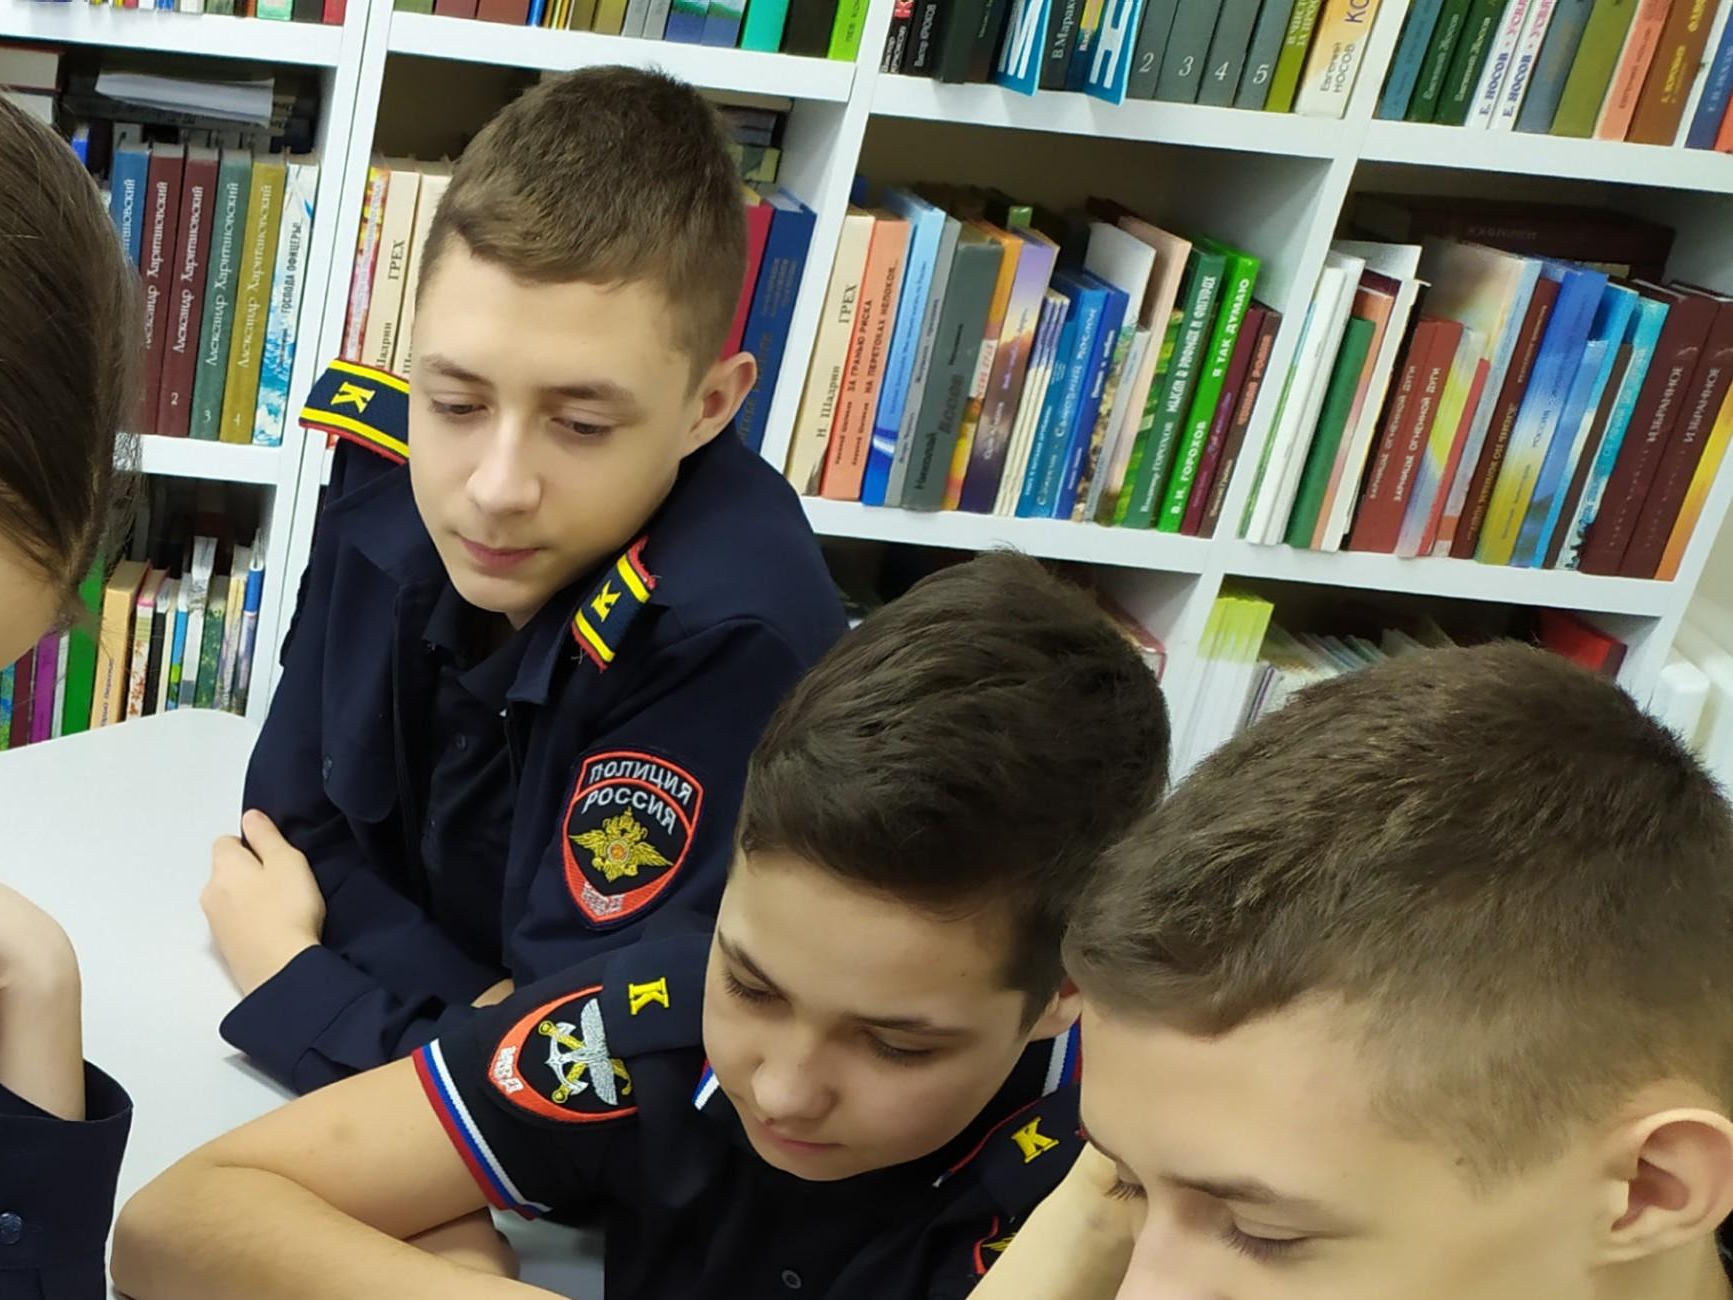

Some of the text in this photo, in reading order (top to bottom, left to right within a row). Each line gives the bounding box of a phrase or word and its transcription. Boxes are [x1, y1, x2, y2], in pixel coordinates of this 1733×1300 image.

[1139, 53, 1154, 73] 2
[1178, 56, 1194, 77] 3
[1214, 61, 1230, 81] 4
[1252, 64, 1270, 85] 5
[1318, 40, 1343, 92] Евгений
[1332, 41, 1356, 94] НОСОВ
[1478, 50, 1509, 116] Е. НОСОВ
[1501, 52, 1532, 118] Е. НОСОВ
[145, 180, 173, 278] Харитановский
[172, 185, 207, 353] Александр Харитановский
[204, 180, 241, 366] Александр Харитановский
[236, 183, 274, 368] Александр Харитановский
[387, 238, 404, 280] ГРЕХ
[280, 274, 295, 313] ГОСПОДА
[837, 282, 857, 324] ГРЕХ
[1224, 278, 1250, 334] ДУМАЮ
[846, 298, 873, 392] ЗА ГРАНЬЮ РИСКА
[864, 317, 886, 394] НА ПЕРЕТОКАХ
[1215, 338, 1231, 363] ТАК
[331, 381, 376, 414] К
[1211, 367, 1222, 377] Я
[171, 391, 179, 405] 2
[204, 409, 211, 423] 3
[815, 364, 843, 438] Н. Шадрин
[1384, 394, 1407, 449] ОГНЕННОЙ
[1402, 364, 1416, 391] ДУГИ
[1408, 395, 1432, 451] ОГНЕННОЙ
[1426, 366, 1440, 393] ДУГИ
[1646, 364, 1683, 443] ИЗБРАННОЕ
[1683, 365, 1721, 443] ИЗБРАННОЕ
[913, 430, 938, 490] Николай
[1151, 420, 1175, 471] ГОРОХОВ
[1170, 419, 1205, 514] В. ГОРОХОВ
[591, 579, 622, 622] К
[589, 761, 693, 805] ПОЛИЦИЯ
[581, 787, 676, 835] РОССИЯ
[628, 977, 669, 1015] К
[1011, 1116, 1059, 1164] К
